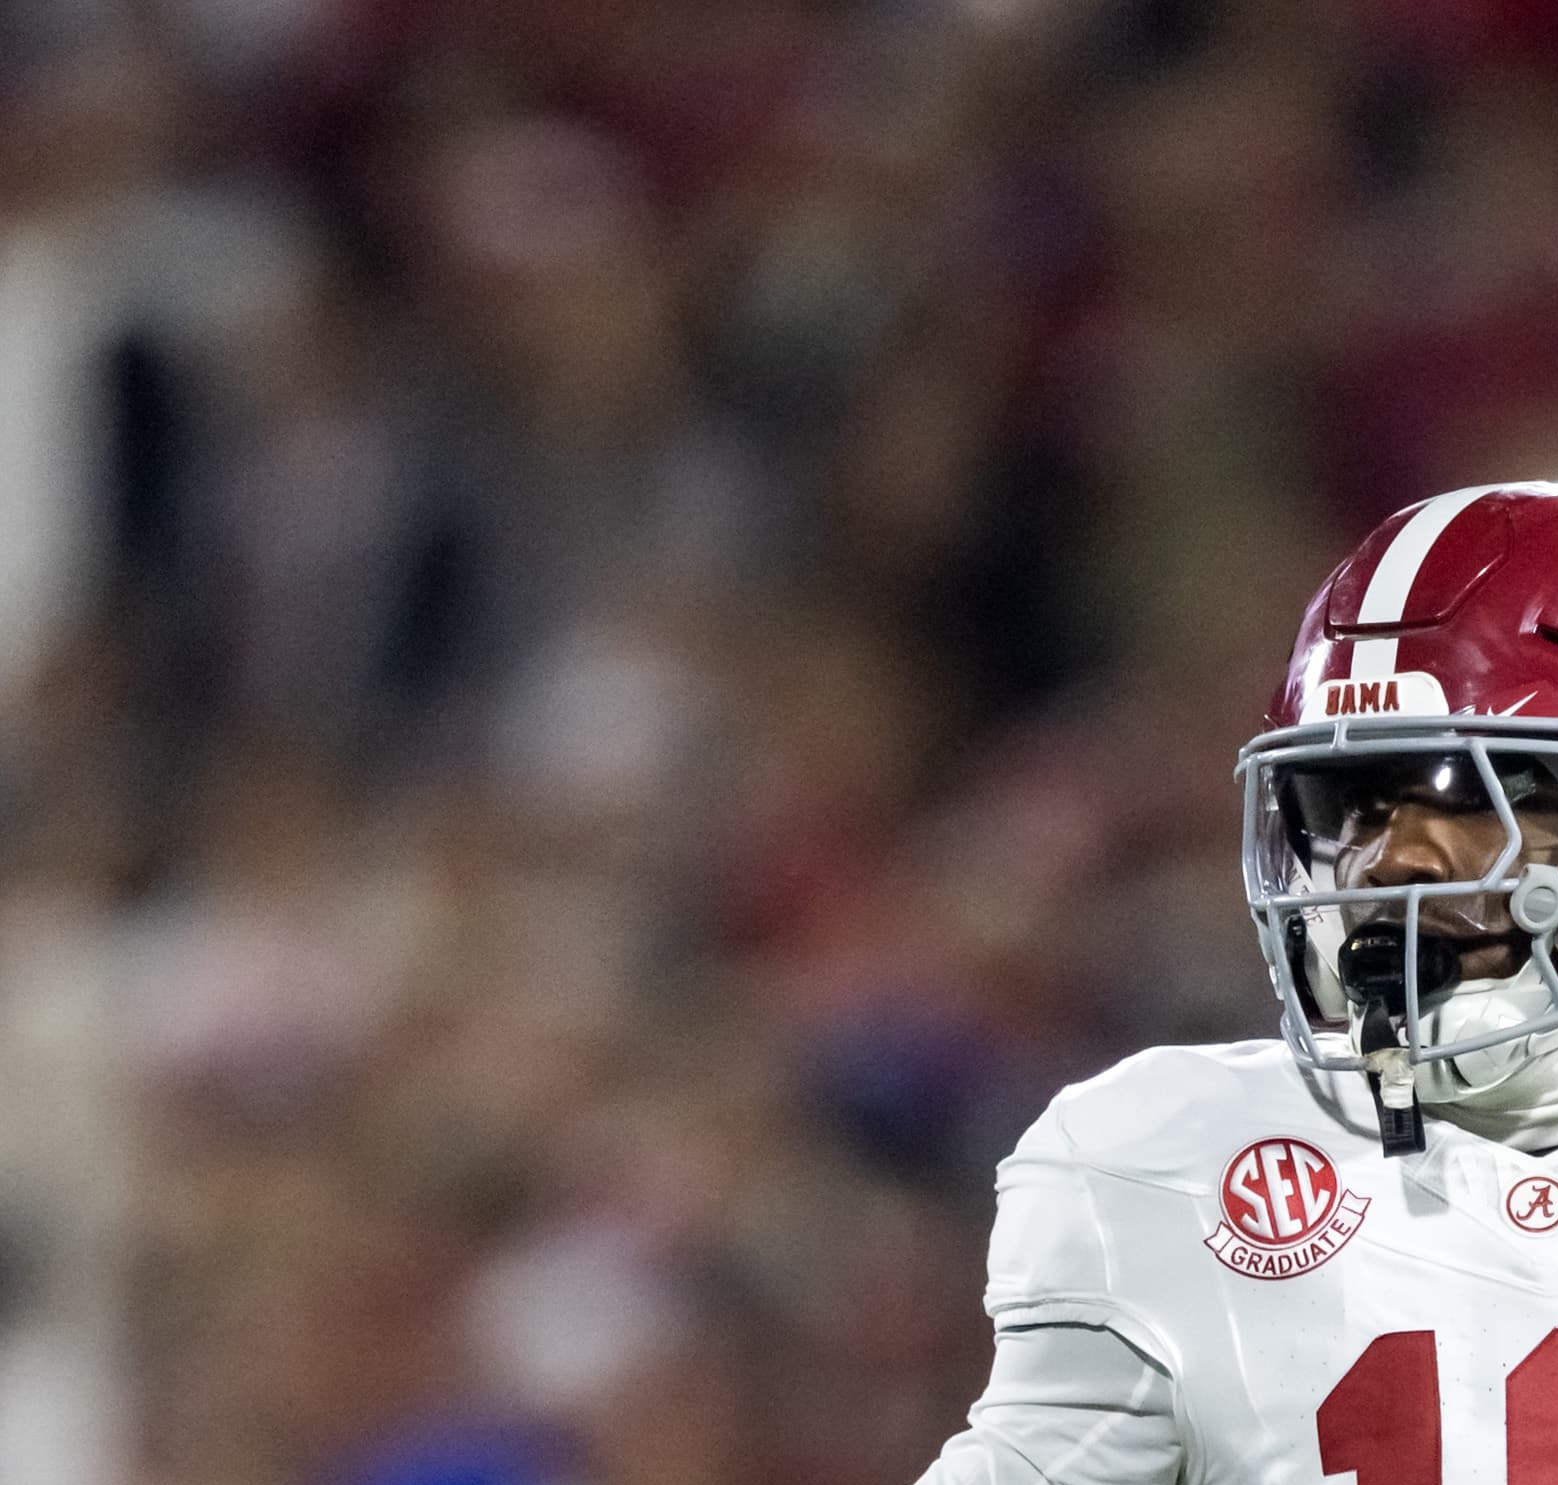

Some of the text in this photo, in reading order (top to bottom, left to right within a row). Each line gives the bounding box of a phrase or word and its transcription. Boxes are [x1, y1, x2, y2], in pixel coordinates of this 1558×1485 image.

[1325, 681, 1400, 716] BAMA
[1229, 1143, 1332, 1240] SEC
[1231, 1218, 1352, 1276] GRADUATE
